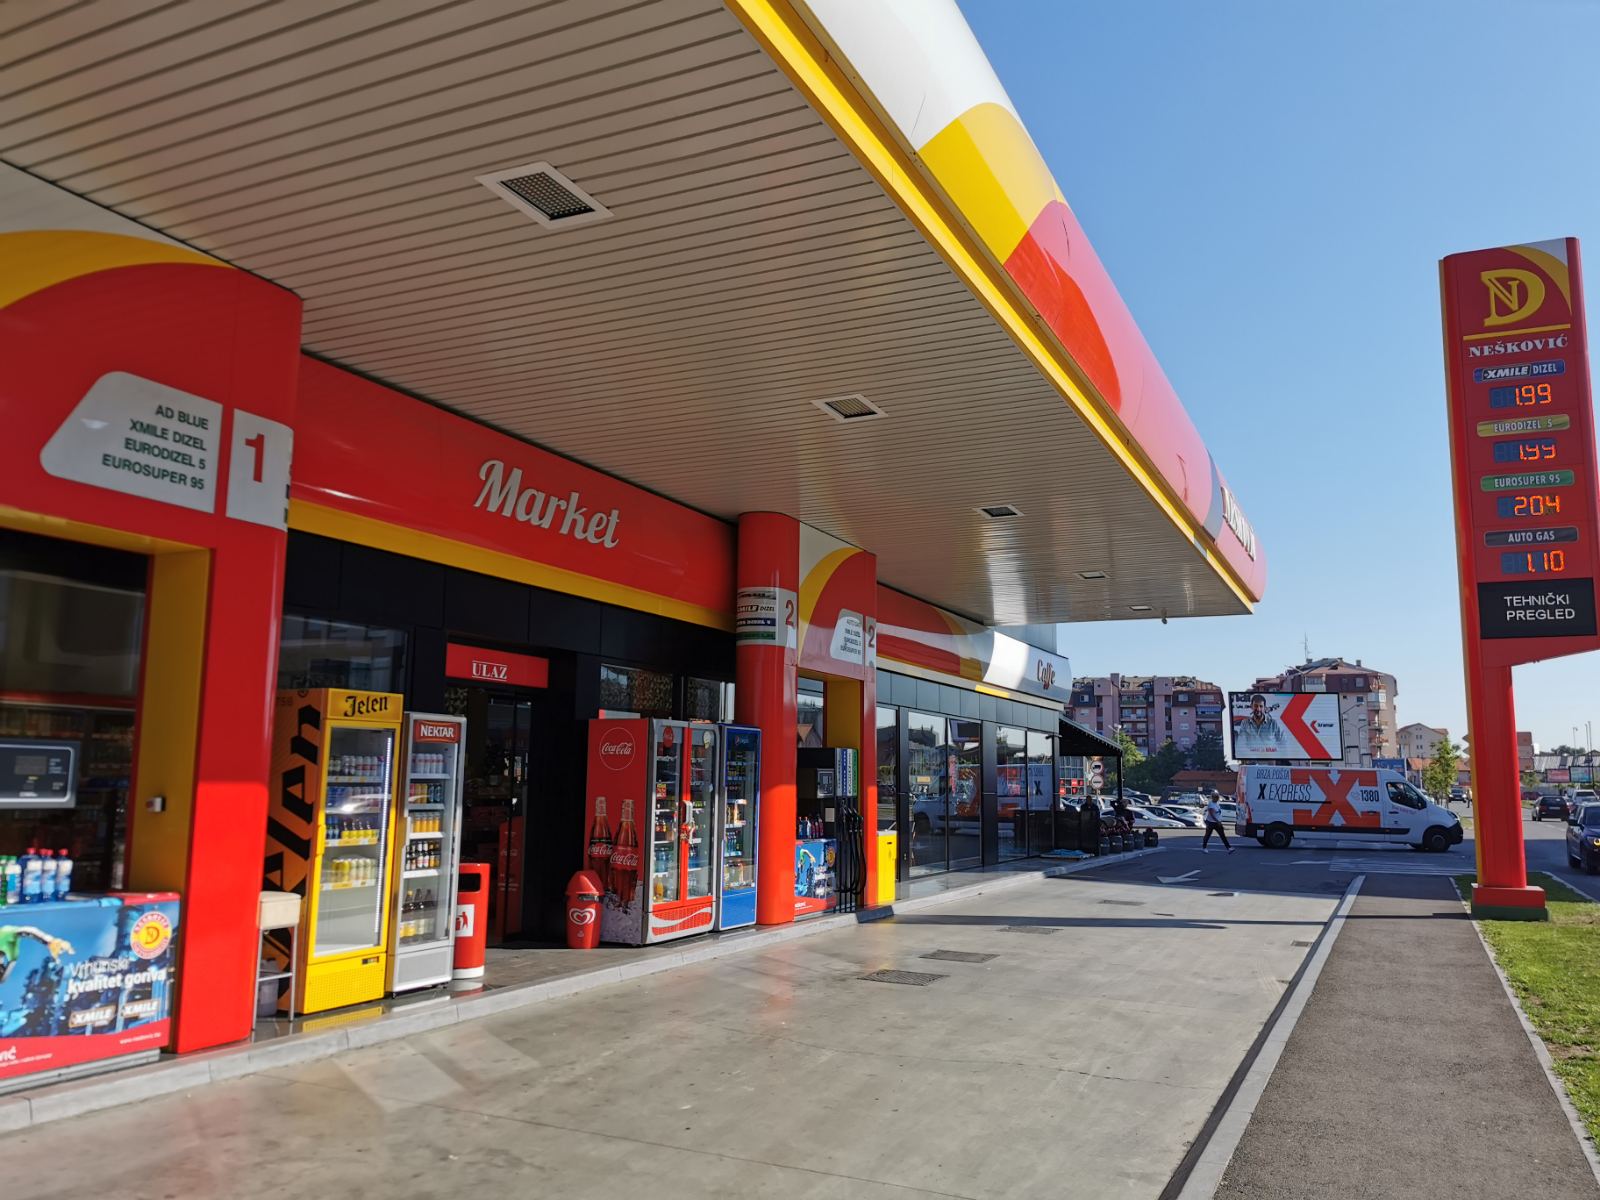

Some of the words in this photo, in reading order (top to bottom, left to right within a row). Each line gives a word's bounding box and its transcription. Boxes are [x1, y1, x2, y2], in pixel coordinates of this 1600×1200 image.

[1468, 333, 1569, 358] NEŠKOVIĆ
[1486, 366, 1529, 379] XMILE
[1532, 363, 1557, 375] DIZEL
[1515, 383, 1552, 406] 1.99
[155, 404, 174, 421] AD
[177, 409, 209, 430] BLUE
[1494, 420, 1542, 433] EURODIZEL
[129, 418, 169, 441] XMILE
[173, 431, 208, 451] DIZEL
[124, 437, 196, 469] EURODIZEL
[198, 458, 206, 470] 5
[245, 433, 265, 483] 1
[102, 453, 188, 487] EUROSUPER
[190, 475, 205, 490] 95
[1494, 475, 1546, 488] EUROSUPER
[1549, 473, 1561, 485] 95
[473, 460, 620, 548] Market
[1507, 531, 1534, 543] AUTO
[1536, 530, 1556, 542] GAS
[1504, 592, 1570, 608] TEHNIČKI
[785, 599, 795, 627] 2
[1506, 608, 1576, 622] PREGLED
[868, 625, 875, 649] 2
[471, 661, 508, 681] ULAZ
[344, 694, 389, 718] Jelen
[420, 724, 454, 738] NEKTAR
[1256, 769, 1271, 780] BRZA
[1258, 783, 1267, 800] X
[1268, 783, 1312, 801] EXPRESS
[1360, 789, 1380, 802] 1380
[67, 974, 122, 1000] kvalitet
